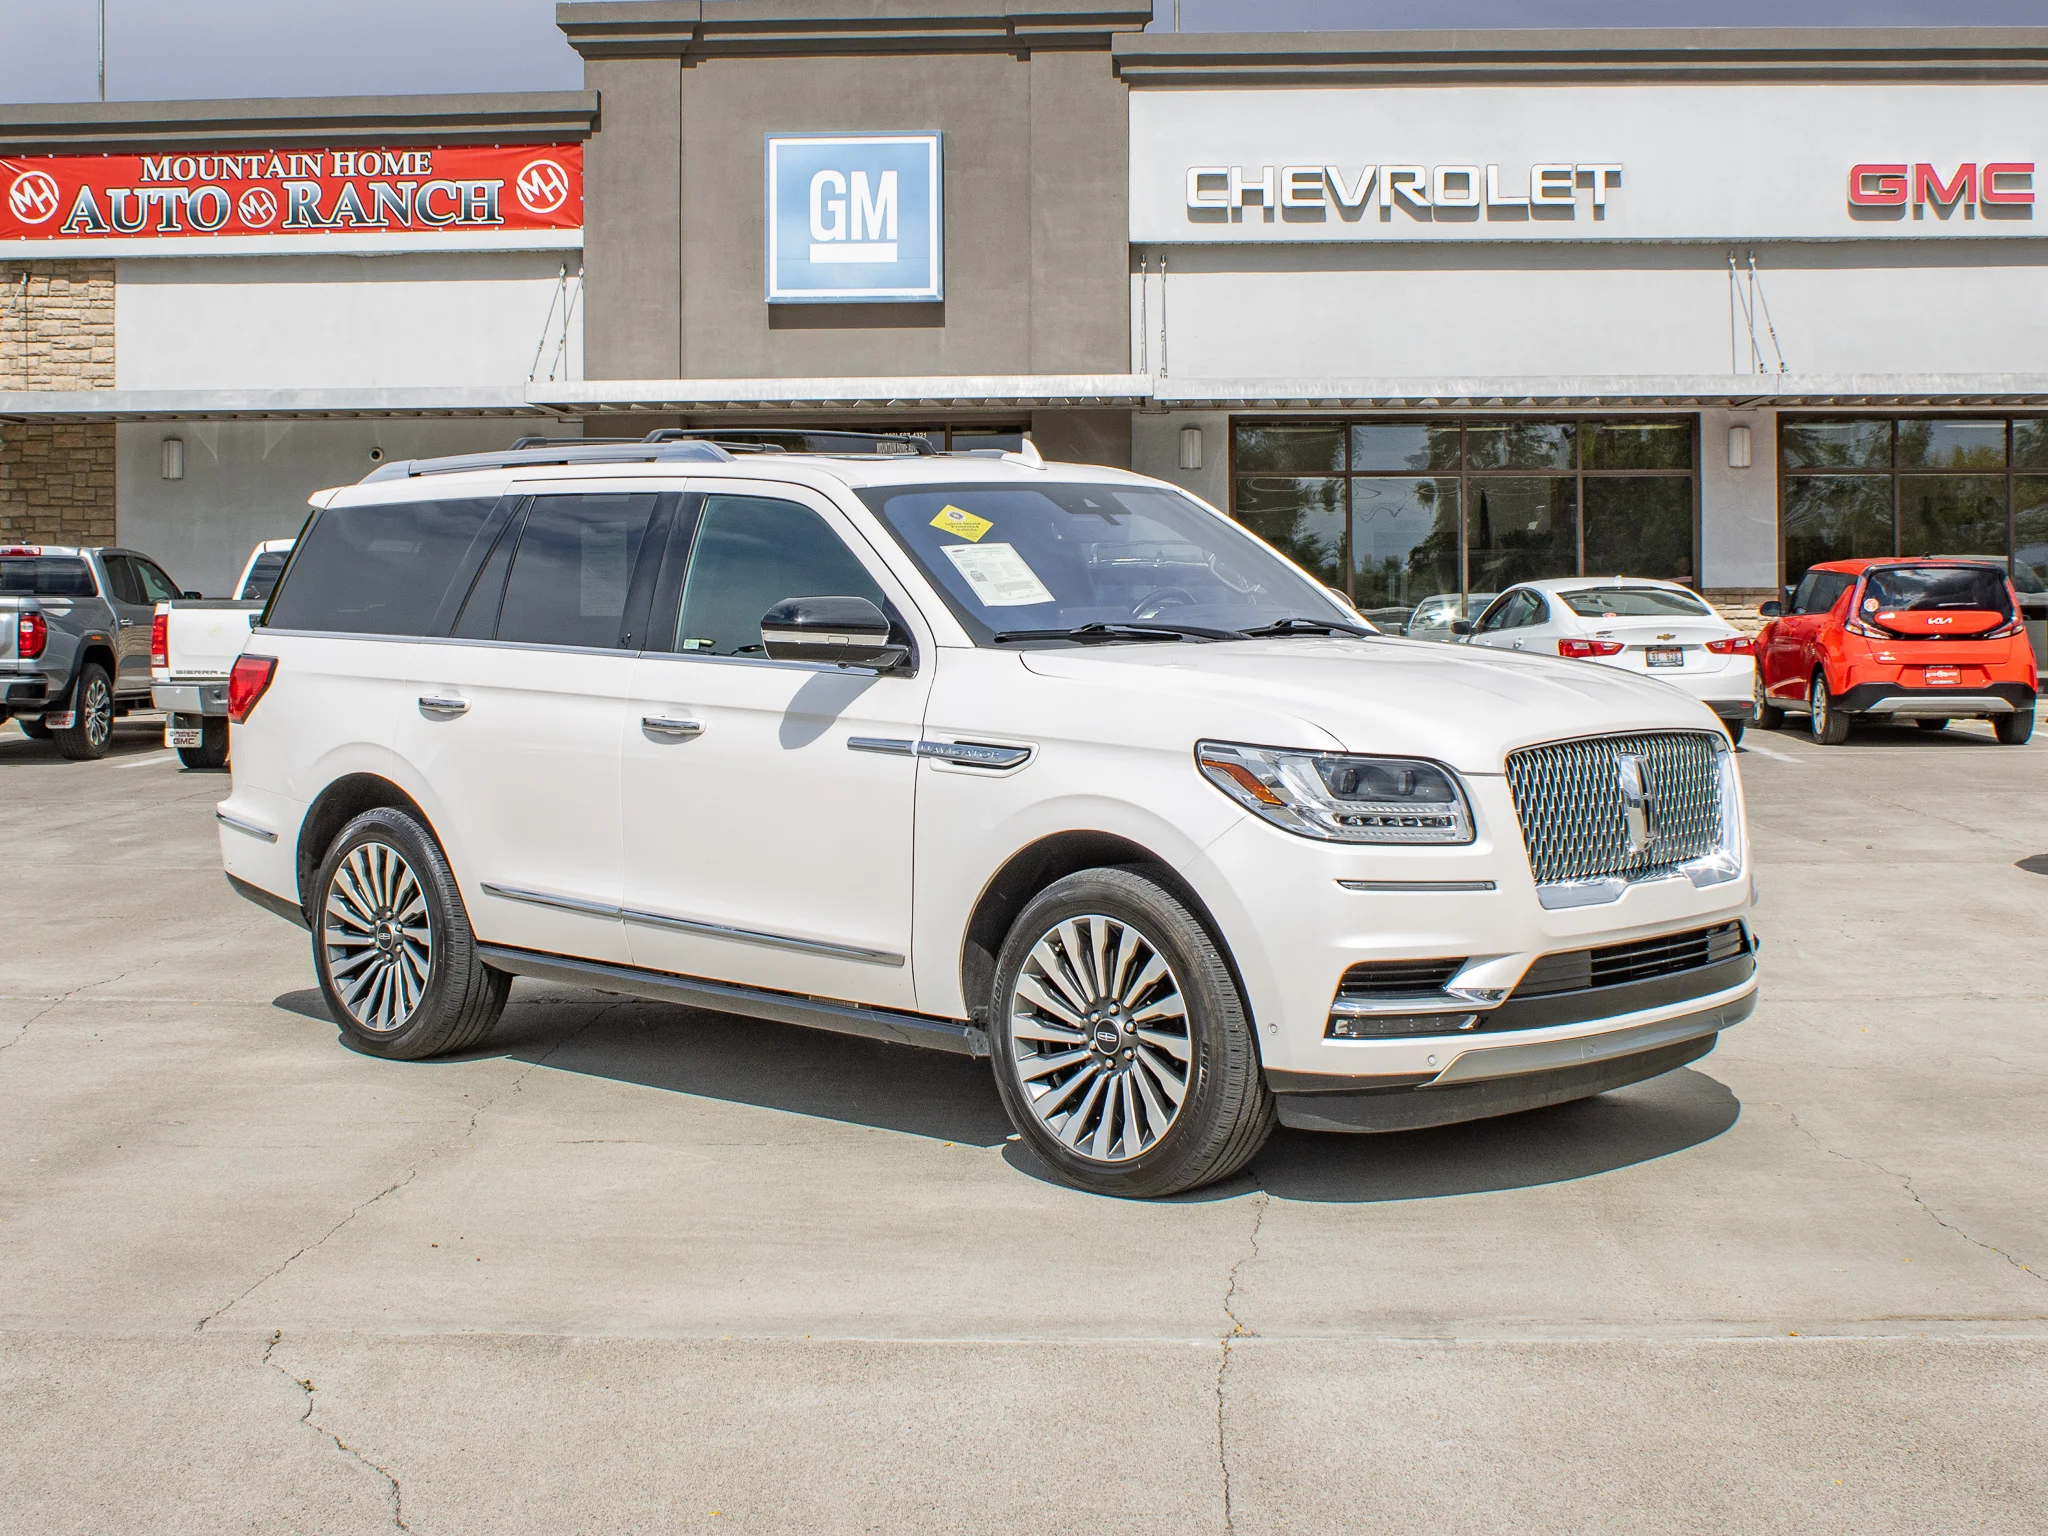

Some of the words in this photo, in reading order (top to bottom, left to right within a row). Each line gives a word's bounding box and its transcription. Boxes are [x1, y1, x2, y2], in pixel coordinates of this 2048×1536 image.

[139, 151, 324, 182] MOUNTAIN
[330, 150, 433, 178] HOME
[1186, 163, 1624, 208] CHEVROLET
[1848, 162, 2035, 205] GMC
[59, 184, 232, 234] AUTO
[281, 178, 505, 229] RANCH
[809, 169, 898, 241] GM
[174, 737, 195, 745] GMC
[919, 743, 1000, 760] NAVIGATOR
